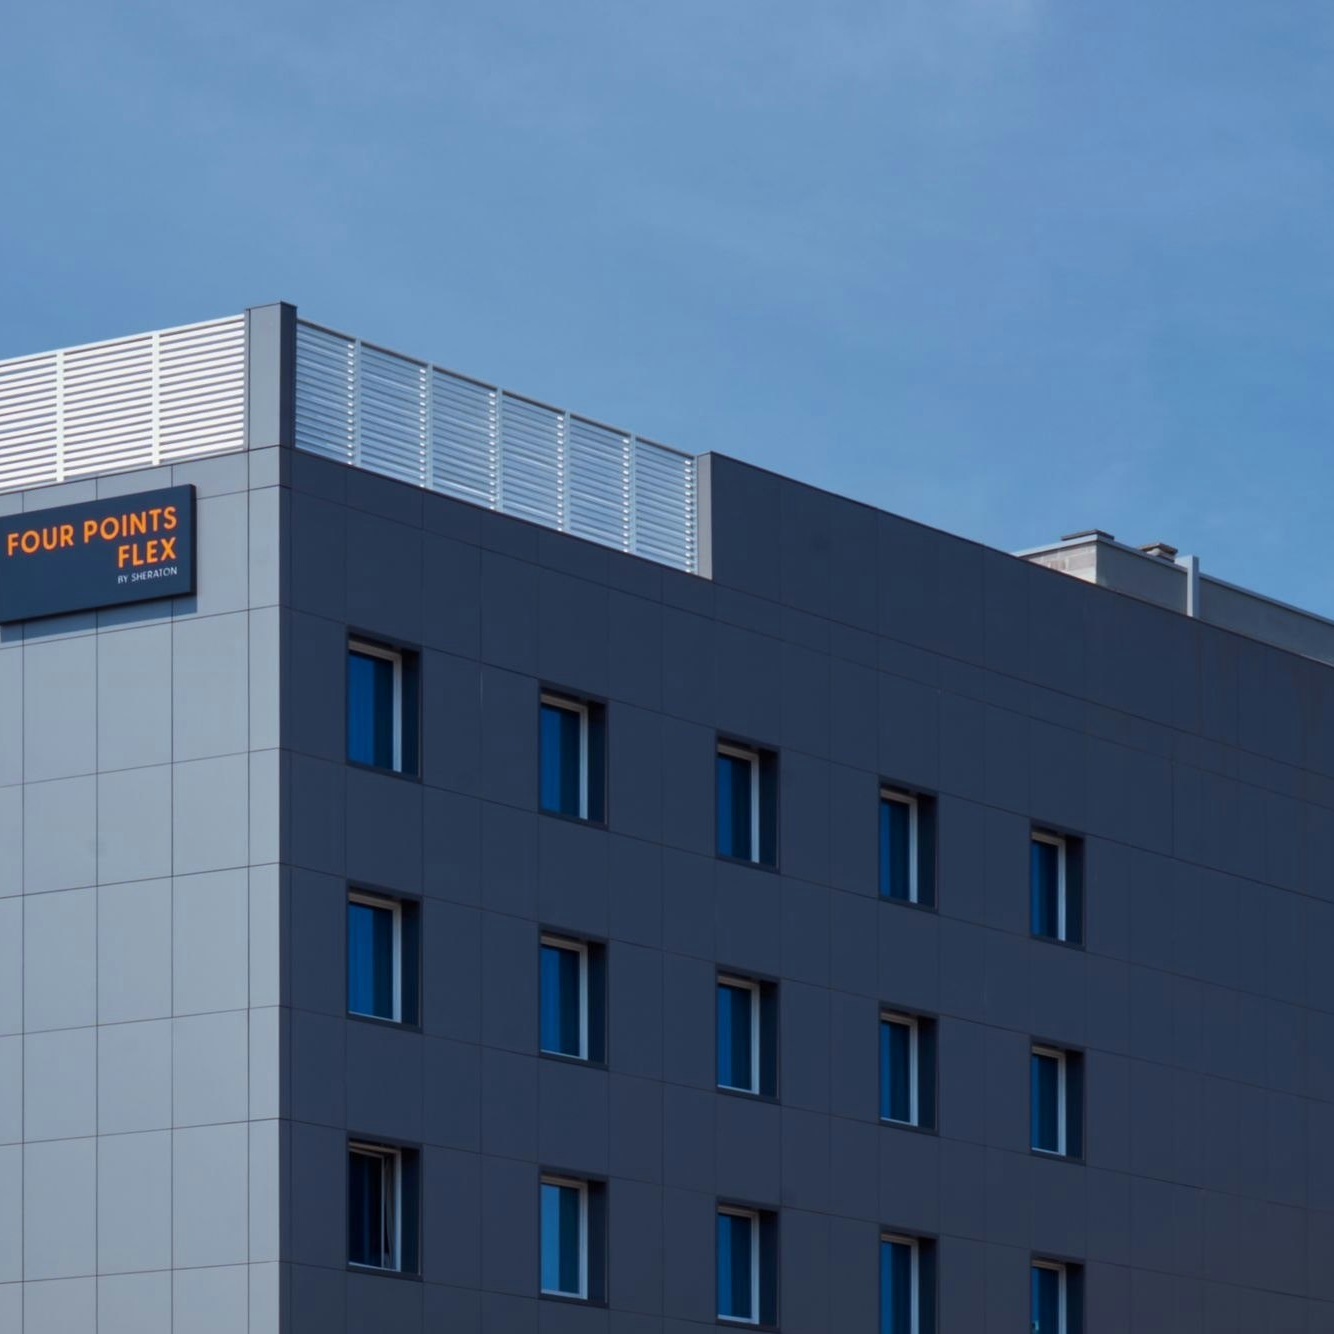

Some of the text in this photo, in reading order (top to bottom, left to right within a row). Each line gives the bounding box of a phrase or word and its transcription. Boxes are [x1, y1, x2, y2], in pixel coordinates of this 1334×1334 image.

[7, 506, 177, 556] FOUR POINTS
[118, 537, 176, 568] FLEX
[118, 567, 178, 584] BY SHERATON
